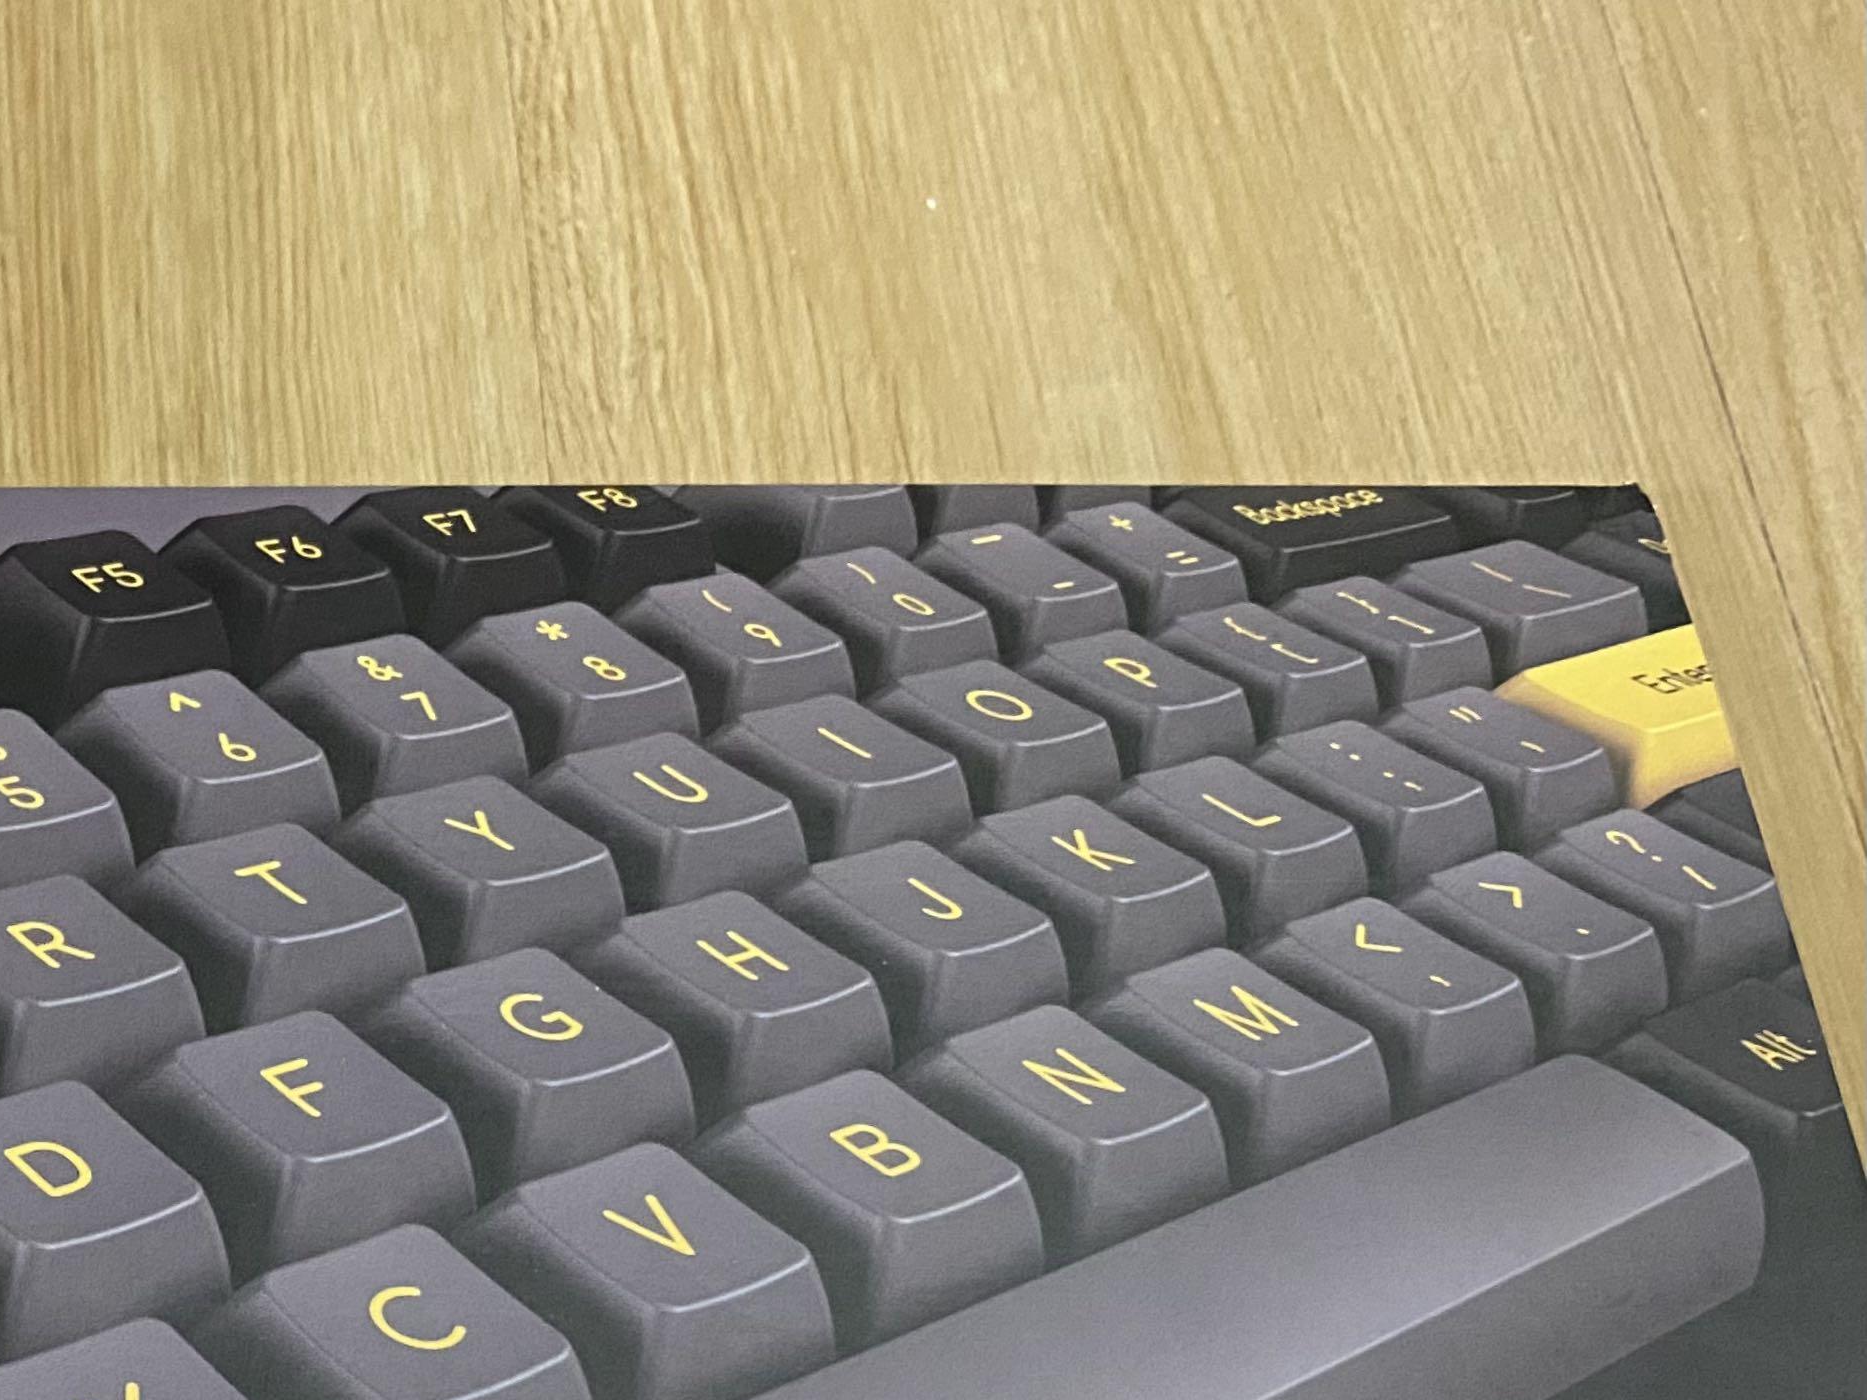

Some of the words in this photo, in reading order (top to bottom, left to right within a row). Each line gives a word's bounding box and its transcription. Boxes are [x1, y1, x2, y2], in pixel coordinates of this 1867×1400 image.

[577, 487, 638, 512] F8
[1232, 489, 1384, 525] Backspace
[422, 509, 477, 536] F7
[255, 535, 323, 563] F6
[71, 562, 144, 593] F5
[743, 623, 782, 647] 9
[356, 655, 403, 681] &
[582, 655, 627, 681] 8
[1103, 657, 1157, 688] P
[400, 691, 437, 721] 7
[965, 689, 1033, 721] O
[218, 732, 257, 762] 6
[633, 764, 709, 803] U
[443, 810, 515, 851] Y
[1202, 793, 1282, 827] L
[1051, 828, 1136, 871] K
[234, 860, 308, 905] T
[907, 877, 963, 920] J
[6, 921, 96, 969] R
[696, 930, 789, 981] H
[499, 993, 584, 1041] G
[1193, 985, 1299, 1041] M
[1741, 1029, 1817, 1071] Alt
[259, 1058, 324, 1118] F
[1022, 1047, 1126, 1105] N
[3, 1141, 93, 1197] D
[829, 1123, 921, 1177] B
[602, 1194, 695, 1256] V
[368, 1286, 467, 1350] C
